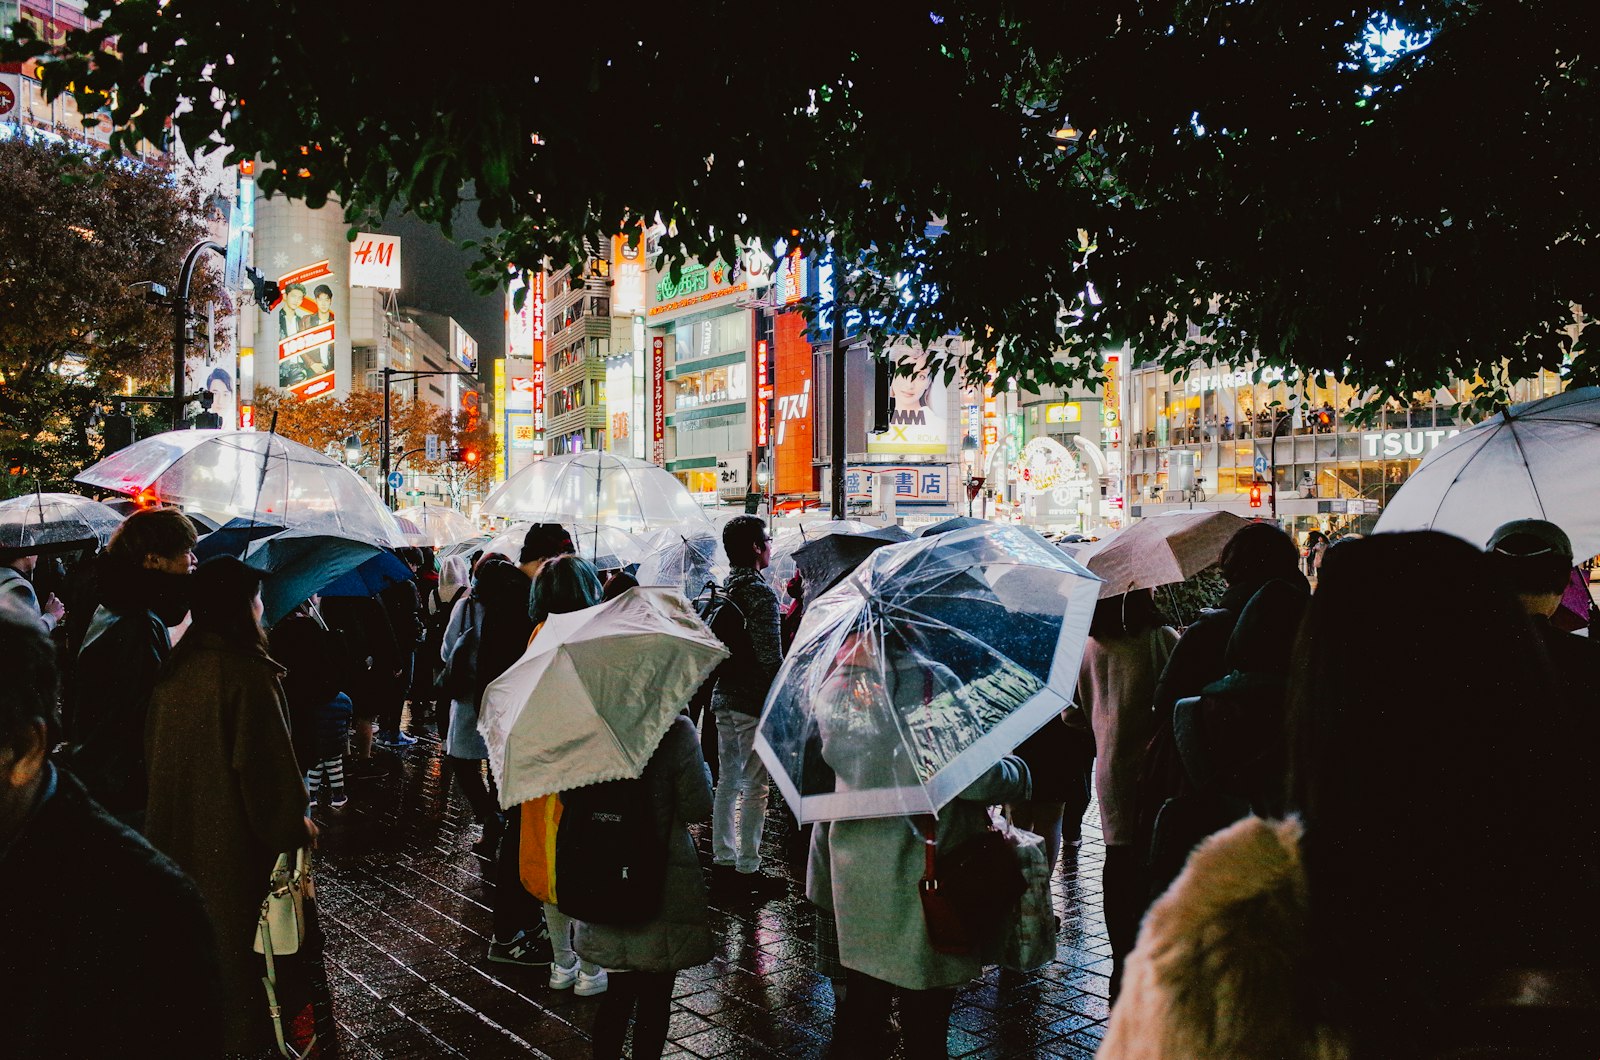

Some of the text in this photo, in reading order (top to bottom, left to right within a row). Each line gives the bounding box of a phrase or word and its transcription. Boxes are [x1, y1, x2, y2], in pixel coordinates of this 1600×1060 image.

[354, 240, 394, 267] H&M
[1364, 430, 1460, 457] TSUT
[508, 945, 526, 959] N
